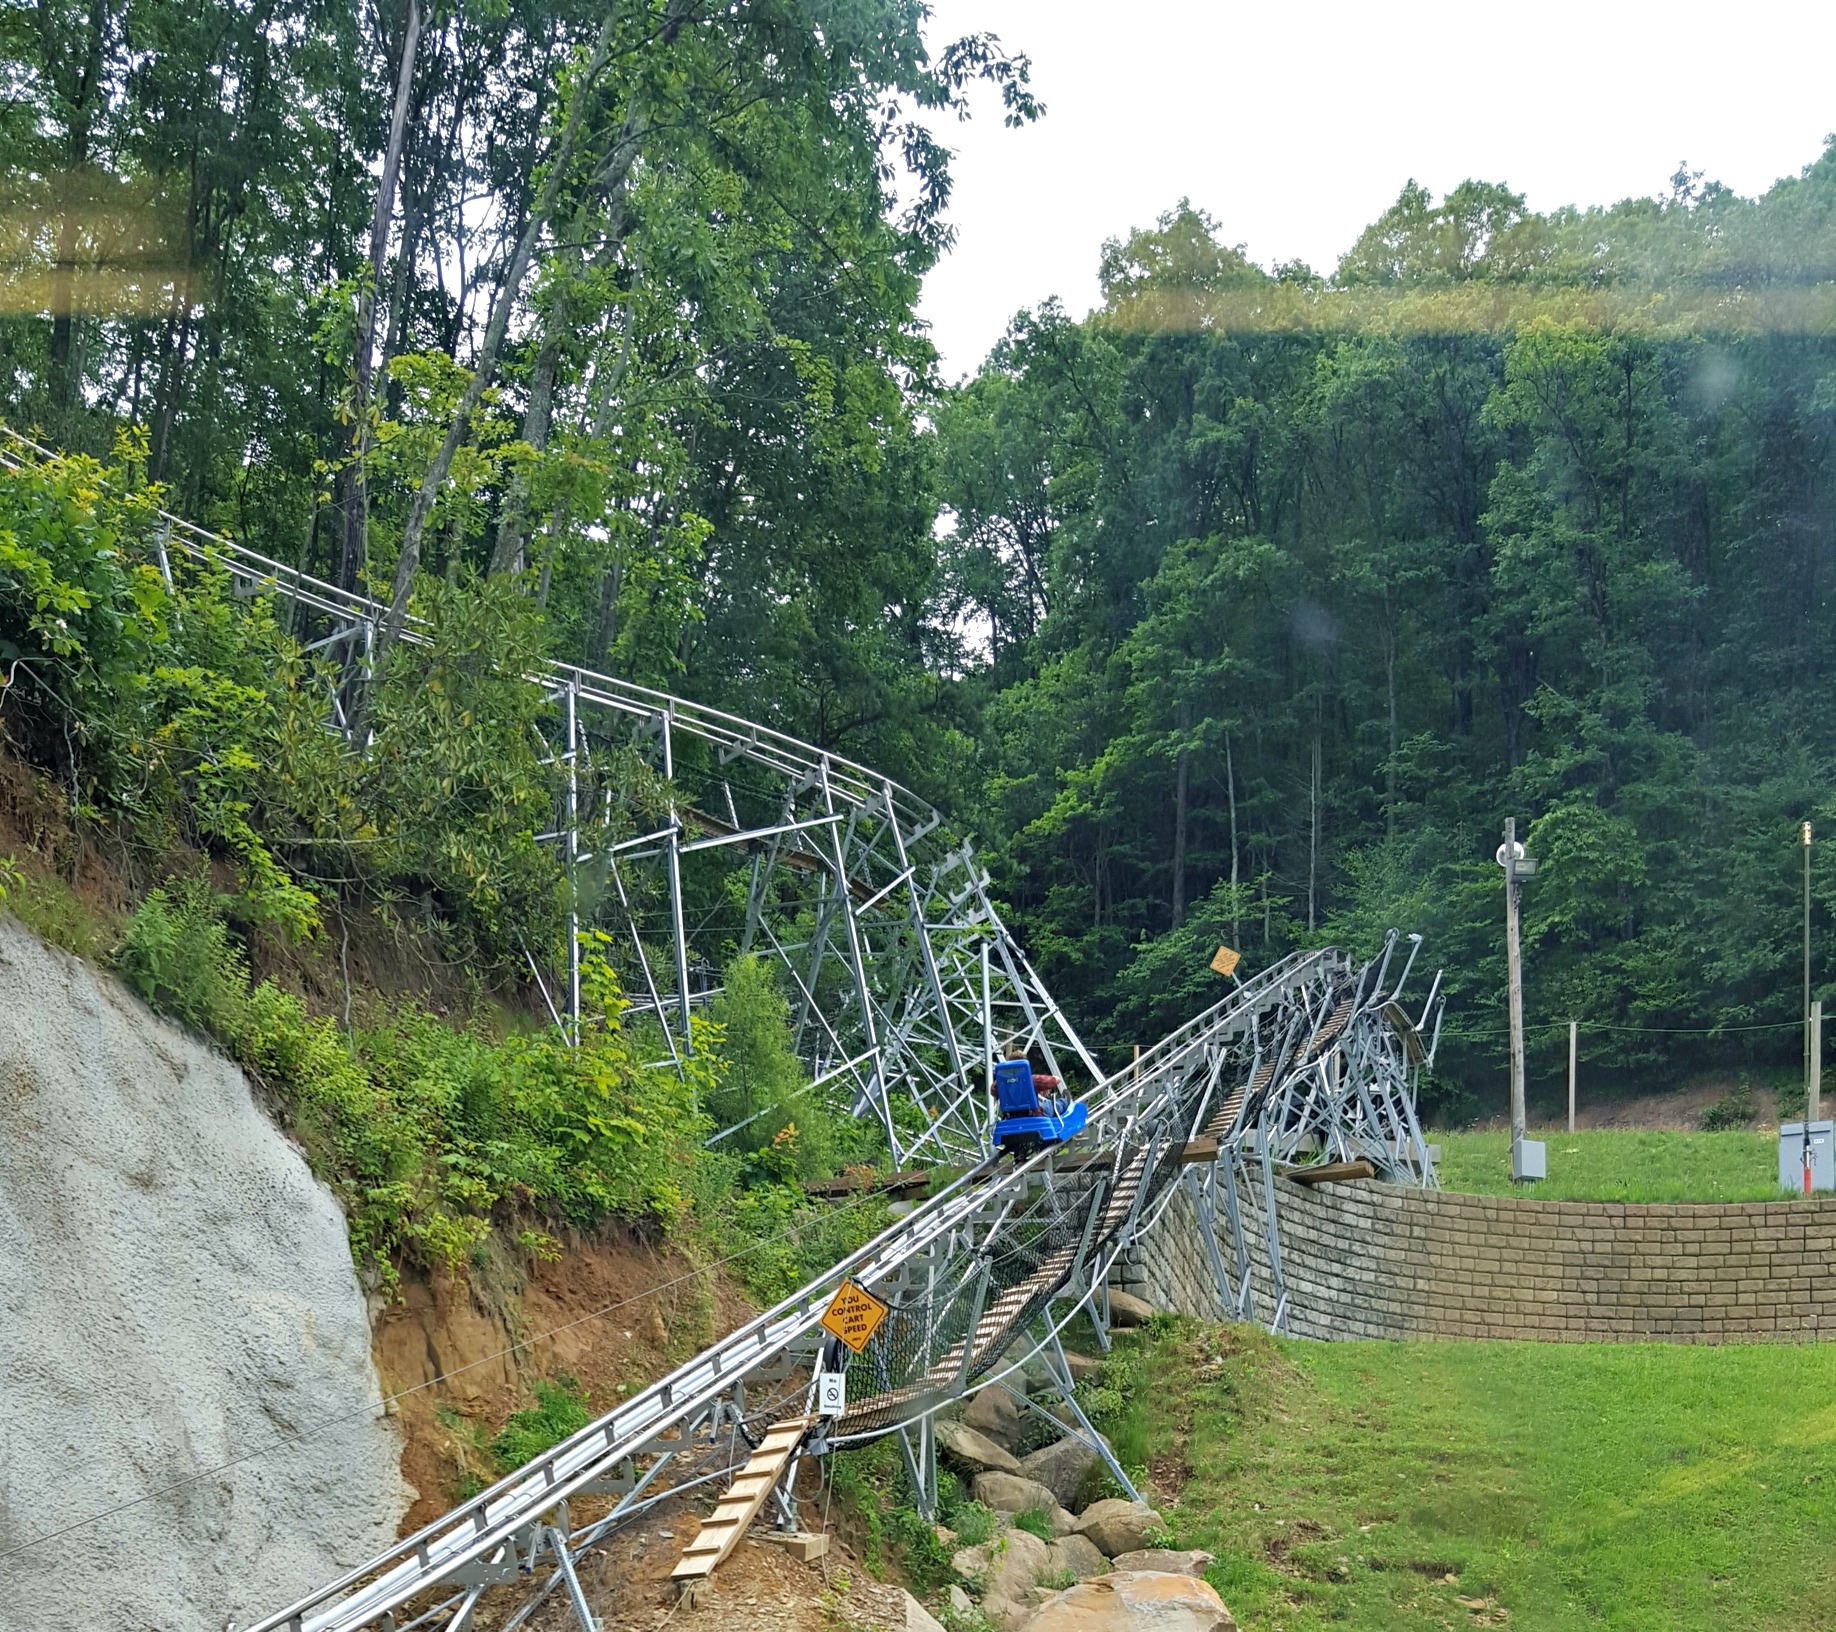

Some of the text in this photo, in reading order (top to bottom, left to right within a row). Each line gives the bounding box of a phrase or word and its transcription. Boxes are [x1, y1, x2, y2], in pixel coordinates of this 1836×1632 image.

[841, 1295, 859, 1305] YOU
[832, 1303, 872, 1316] CONTROL
[843, 1314, 864, 1324] CART
[844, 1324, 867, 1334] SPEED
